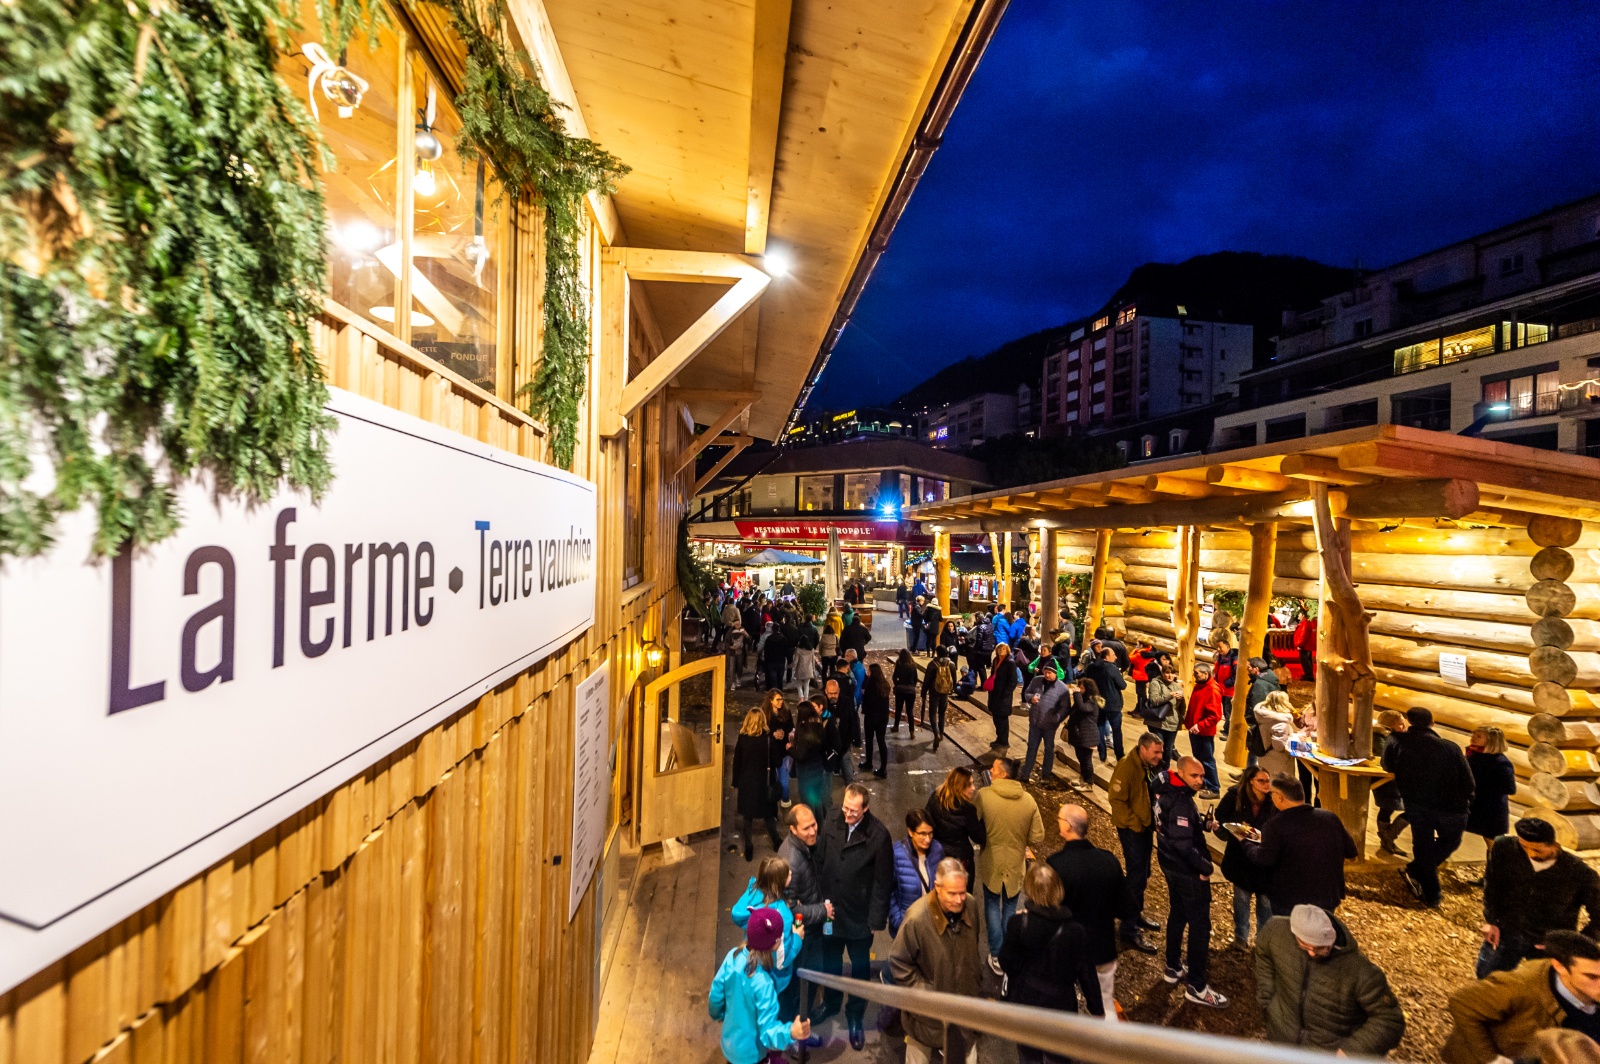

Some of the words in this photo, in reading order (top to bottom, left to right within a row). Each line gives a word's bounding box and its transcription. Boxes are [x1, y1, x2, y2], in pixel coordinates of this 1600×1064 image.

[450, 352, 488, 362] FONDUE
[753, 526, 800, 534] RESTAURANT
[819, 525, 875, 535] MÉROPOLE"
[107, 536, 236, 716] La
[269, 507, 435, 669] ferme
[475, 520, 533, 610] Terre
[538, 525, 592, 593] vaudoise
